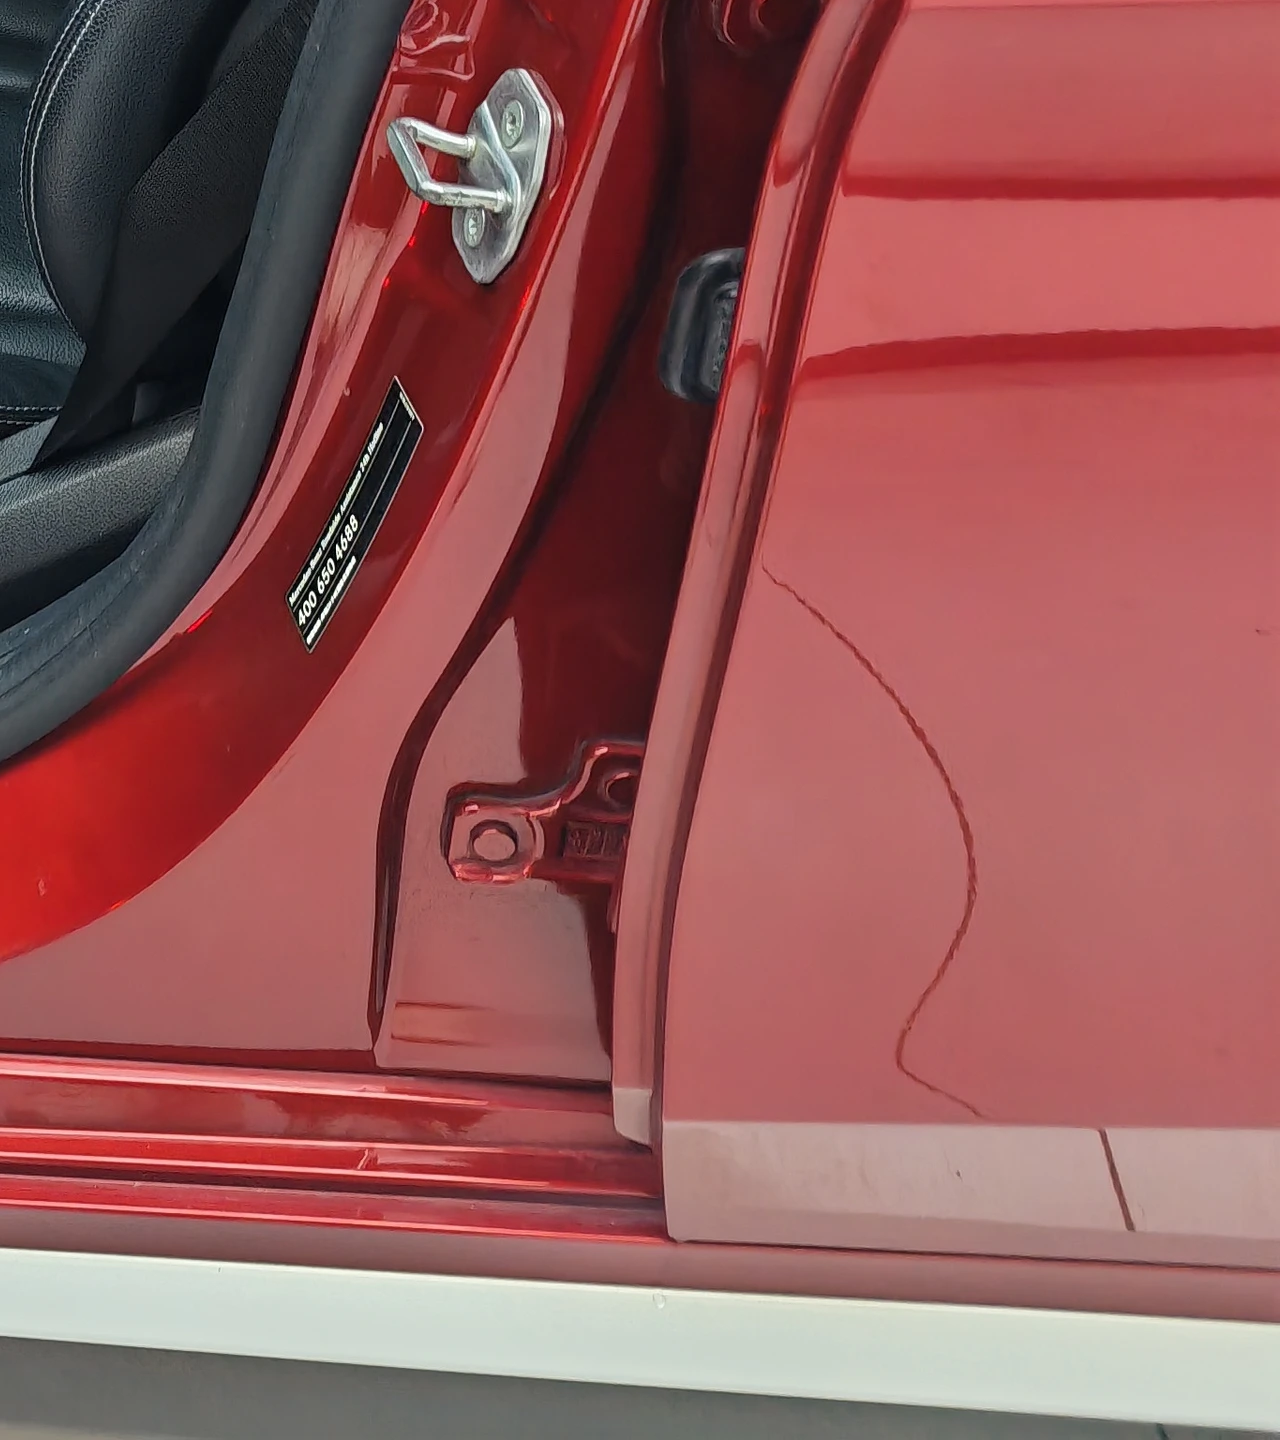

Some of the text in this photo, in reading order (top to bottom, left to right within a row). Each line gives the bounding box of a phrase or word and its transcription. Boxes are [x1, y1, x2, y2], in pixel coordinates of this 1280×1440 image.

[298, 514, 359, 627] 400 650 4688
